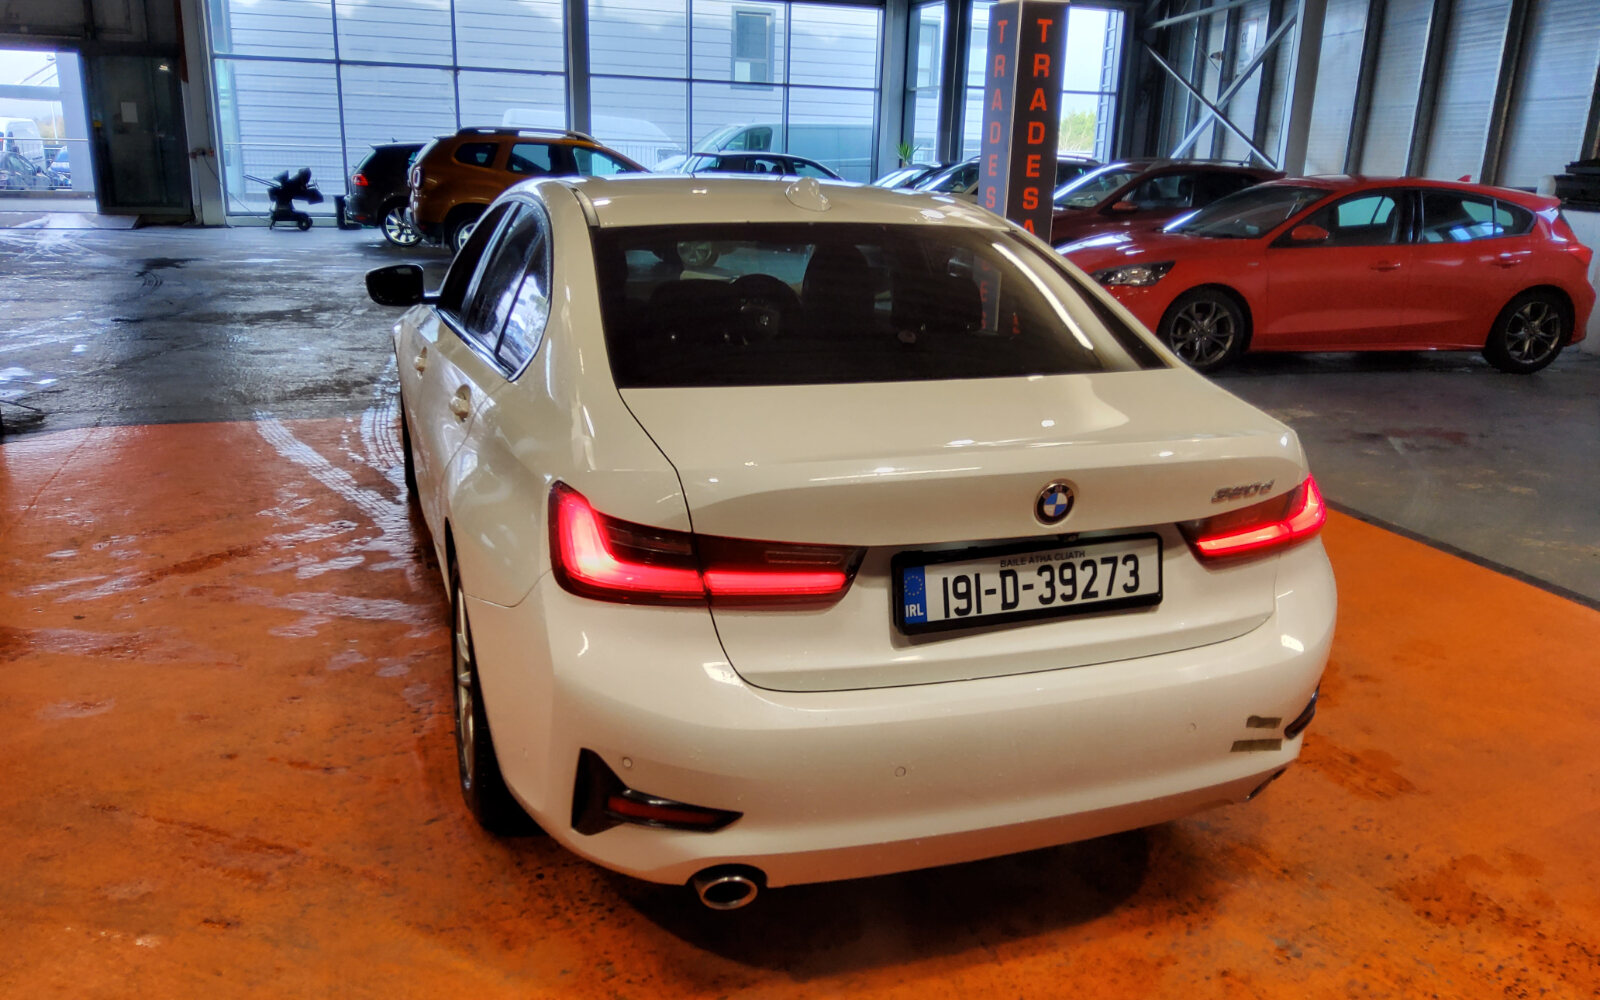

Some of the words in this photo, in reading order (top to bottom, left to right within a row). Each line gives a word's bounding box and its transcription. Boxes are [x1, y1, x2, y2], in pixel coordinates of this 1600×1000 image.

[1000, 559, 1026, 568] BAILE
[1054, 550, 1086, 561] CLIATH
[942, 553, 1140, 619] 191-D-39273
[905, 604, 924, 617] IRL
